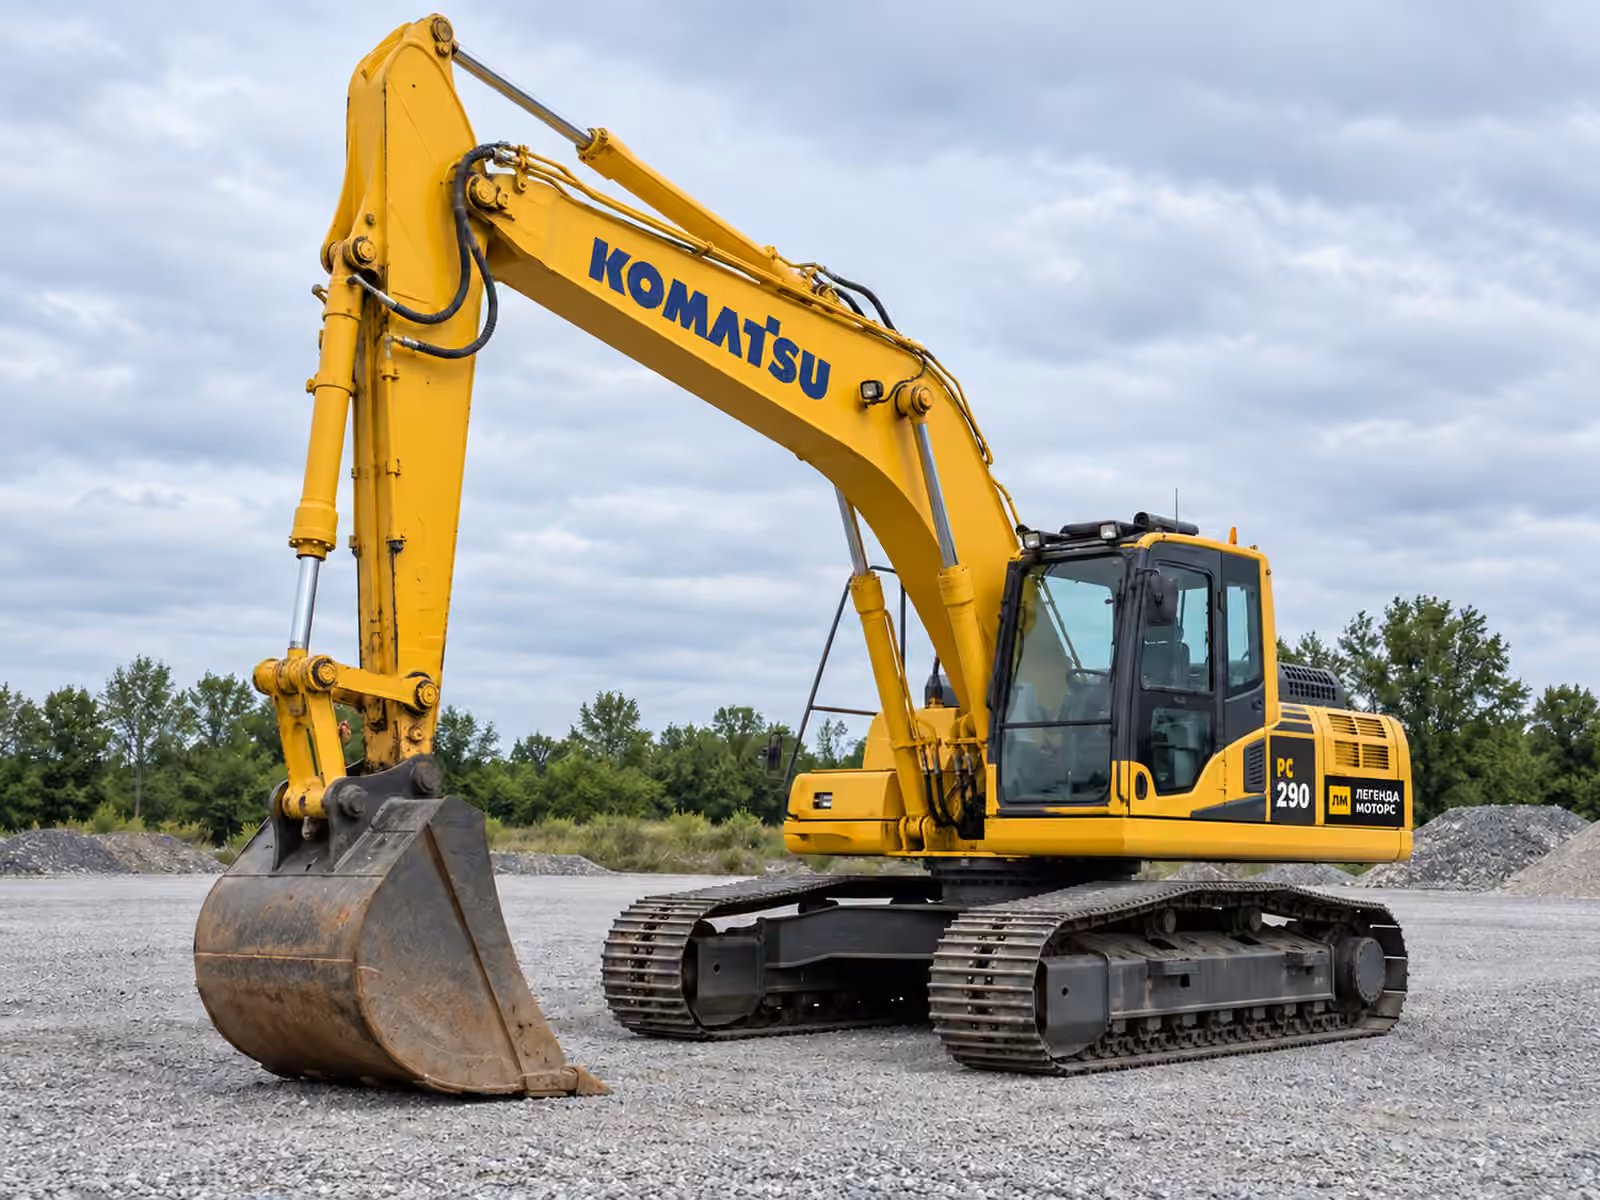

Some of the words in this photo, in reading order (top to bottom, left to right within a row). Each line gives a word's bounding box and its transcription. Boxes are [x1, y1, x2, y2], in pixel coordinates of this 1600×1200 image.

[588, 237, 831, 400] KOMATSU
[1277, 758, 1293, 778] PC
[1276, 782, 1309, 808] 290
[1332, 795, 1348, 807] ЛМ
[1356, 788, 1400, 802] ЛЕГЕНДА
[1356, 803, 1396, 815] МОТОРС
